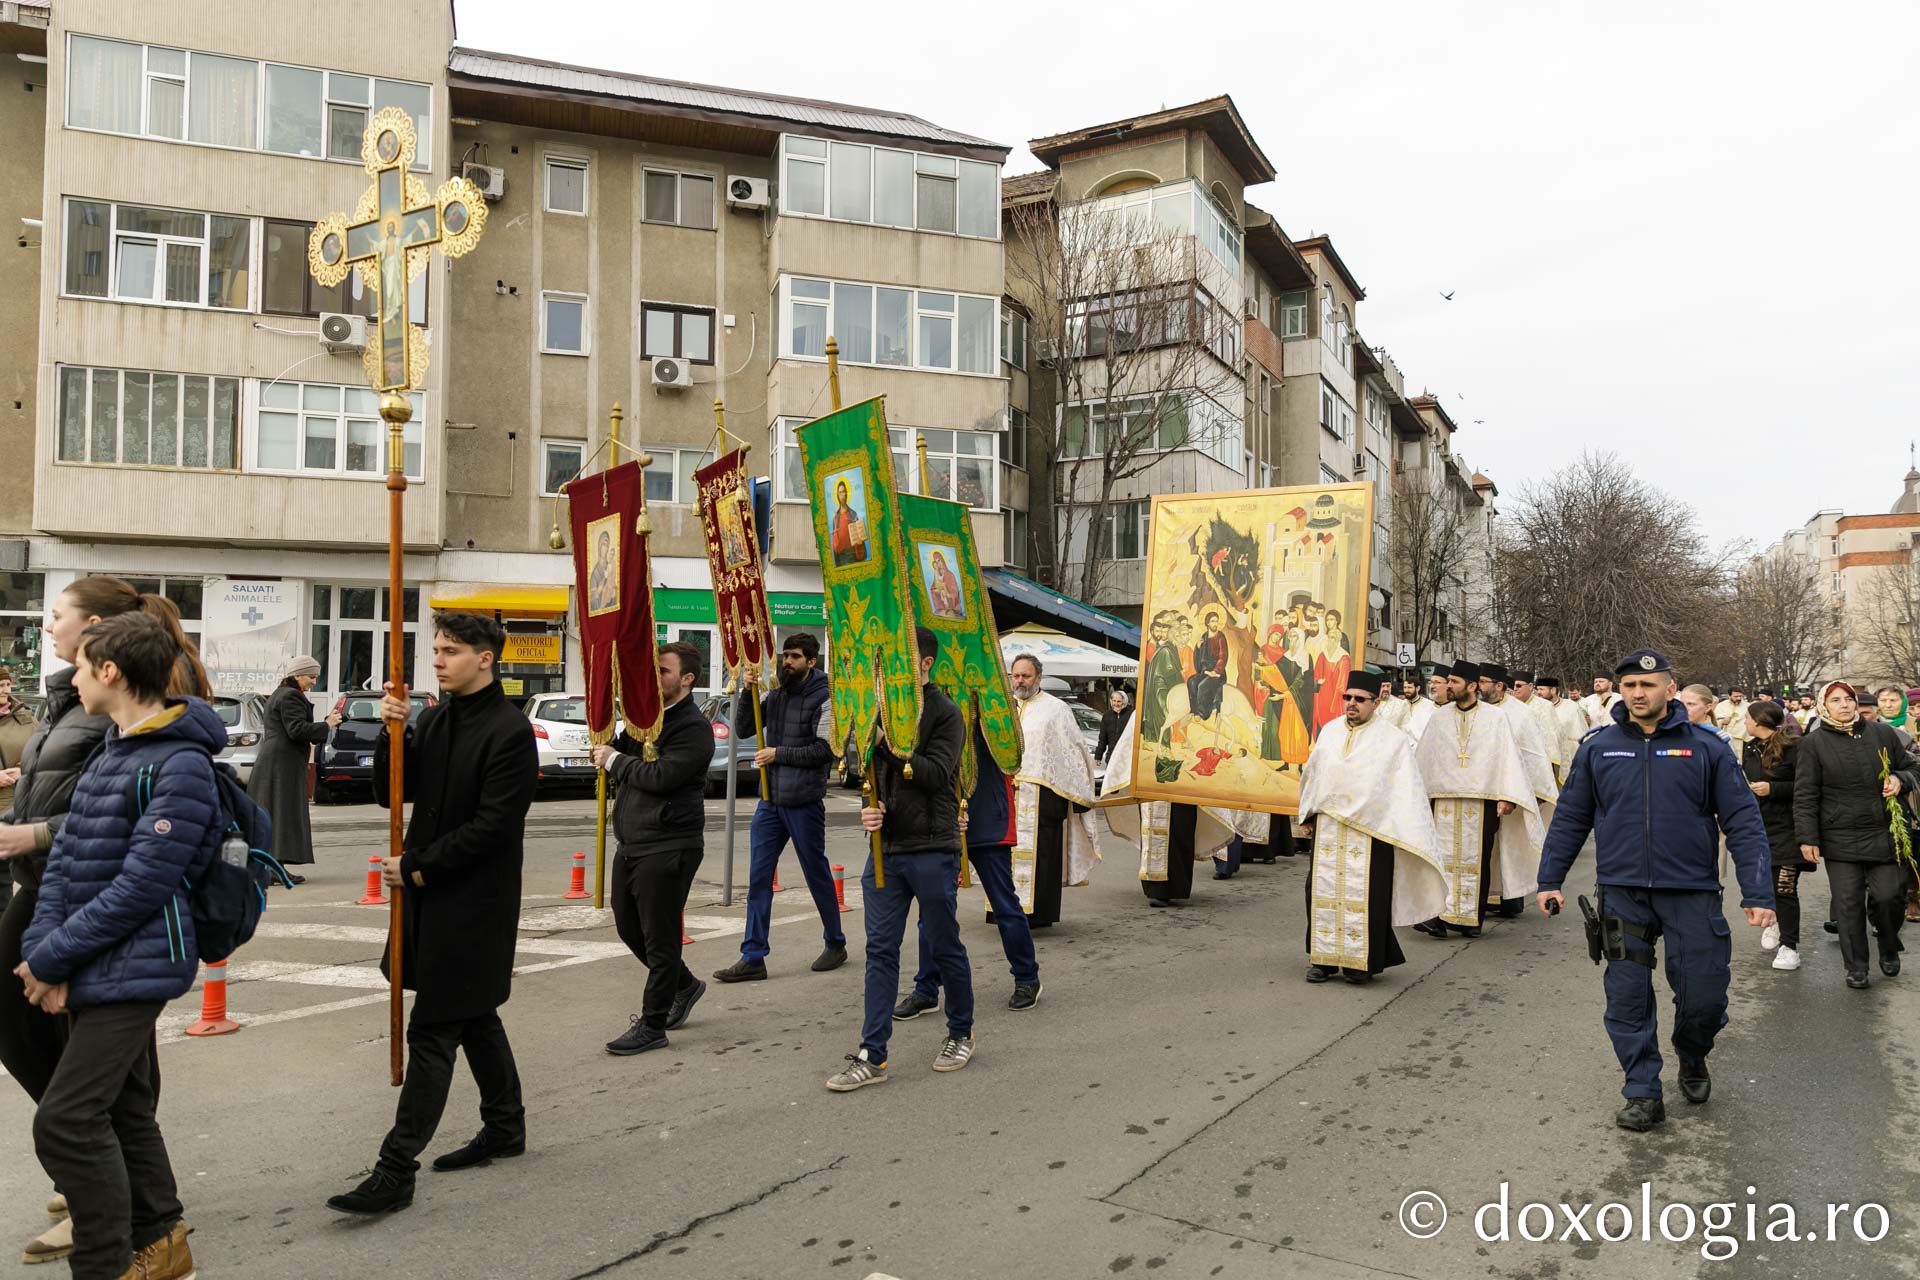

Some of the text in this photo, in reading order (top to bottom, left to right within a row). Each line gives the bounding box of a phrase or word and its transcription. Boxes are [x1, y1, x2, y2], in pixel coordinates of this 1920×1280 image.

[223, 594, 282, 603] ANIMALELE
[509, 636, 554, 646] MONITORUL
[516, 648, 546, 657] OFICIAL
[1101, 663, 1138, 674] Bergenbier
[217, 672, 244, 682] PET
